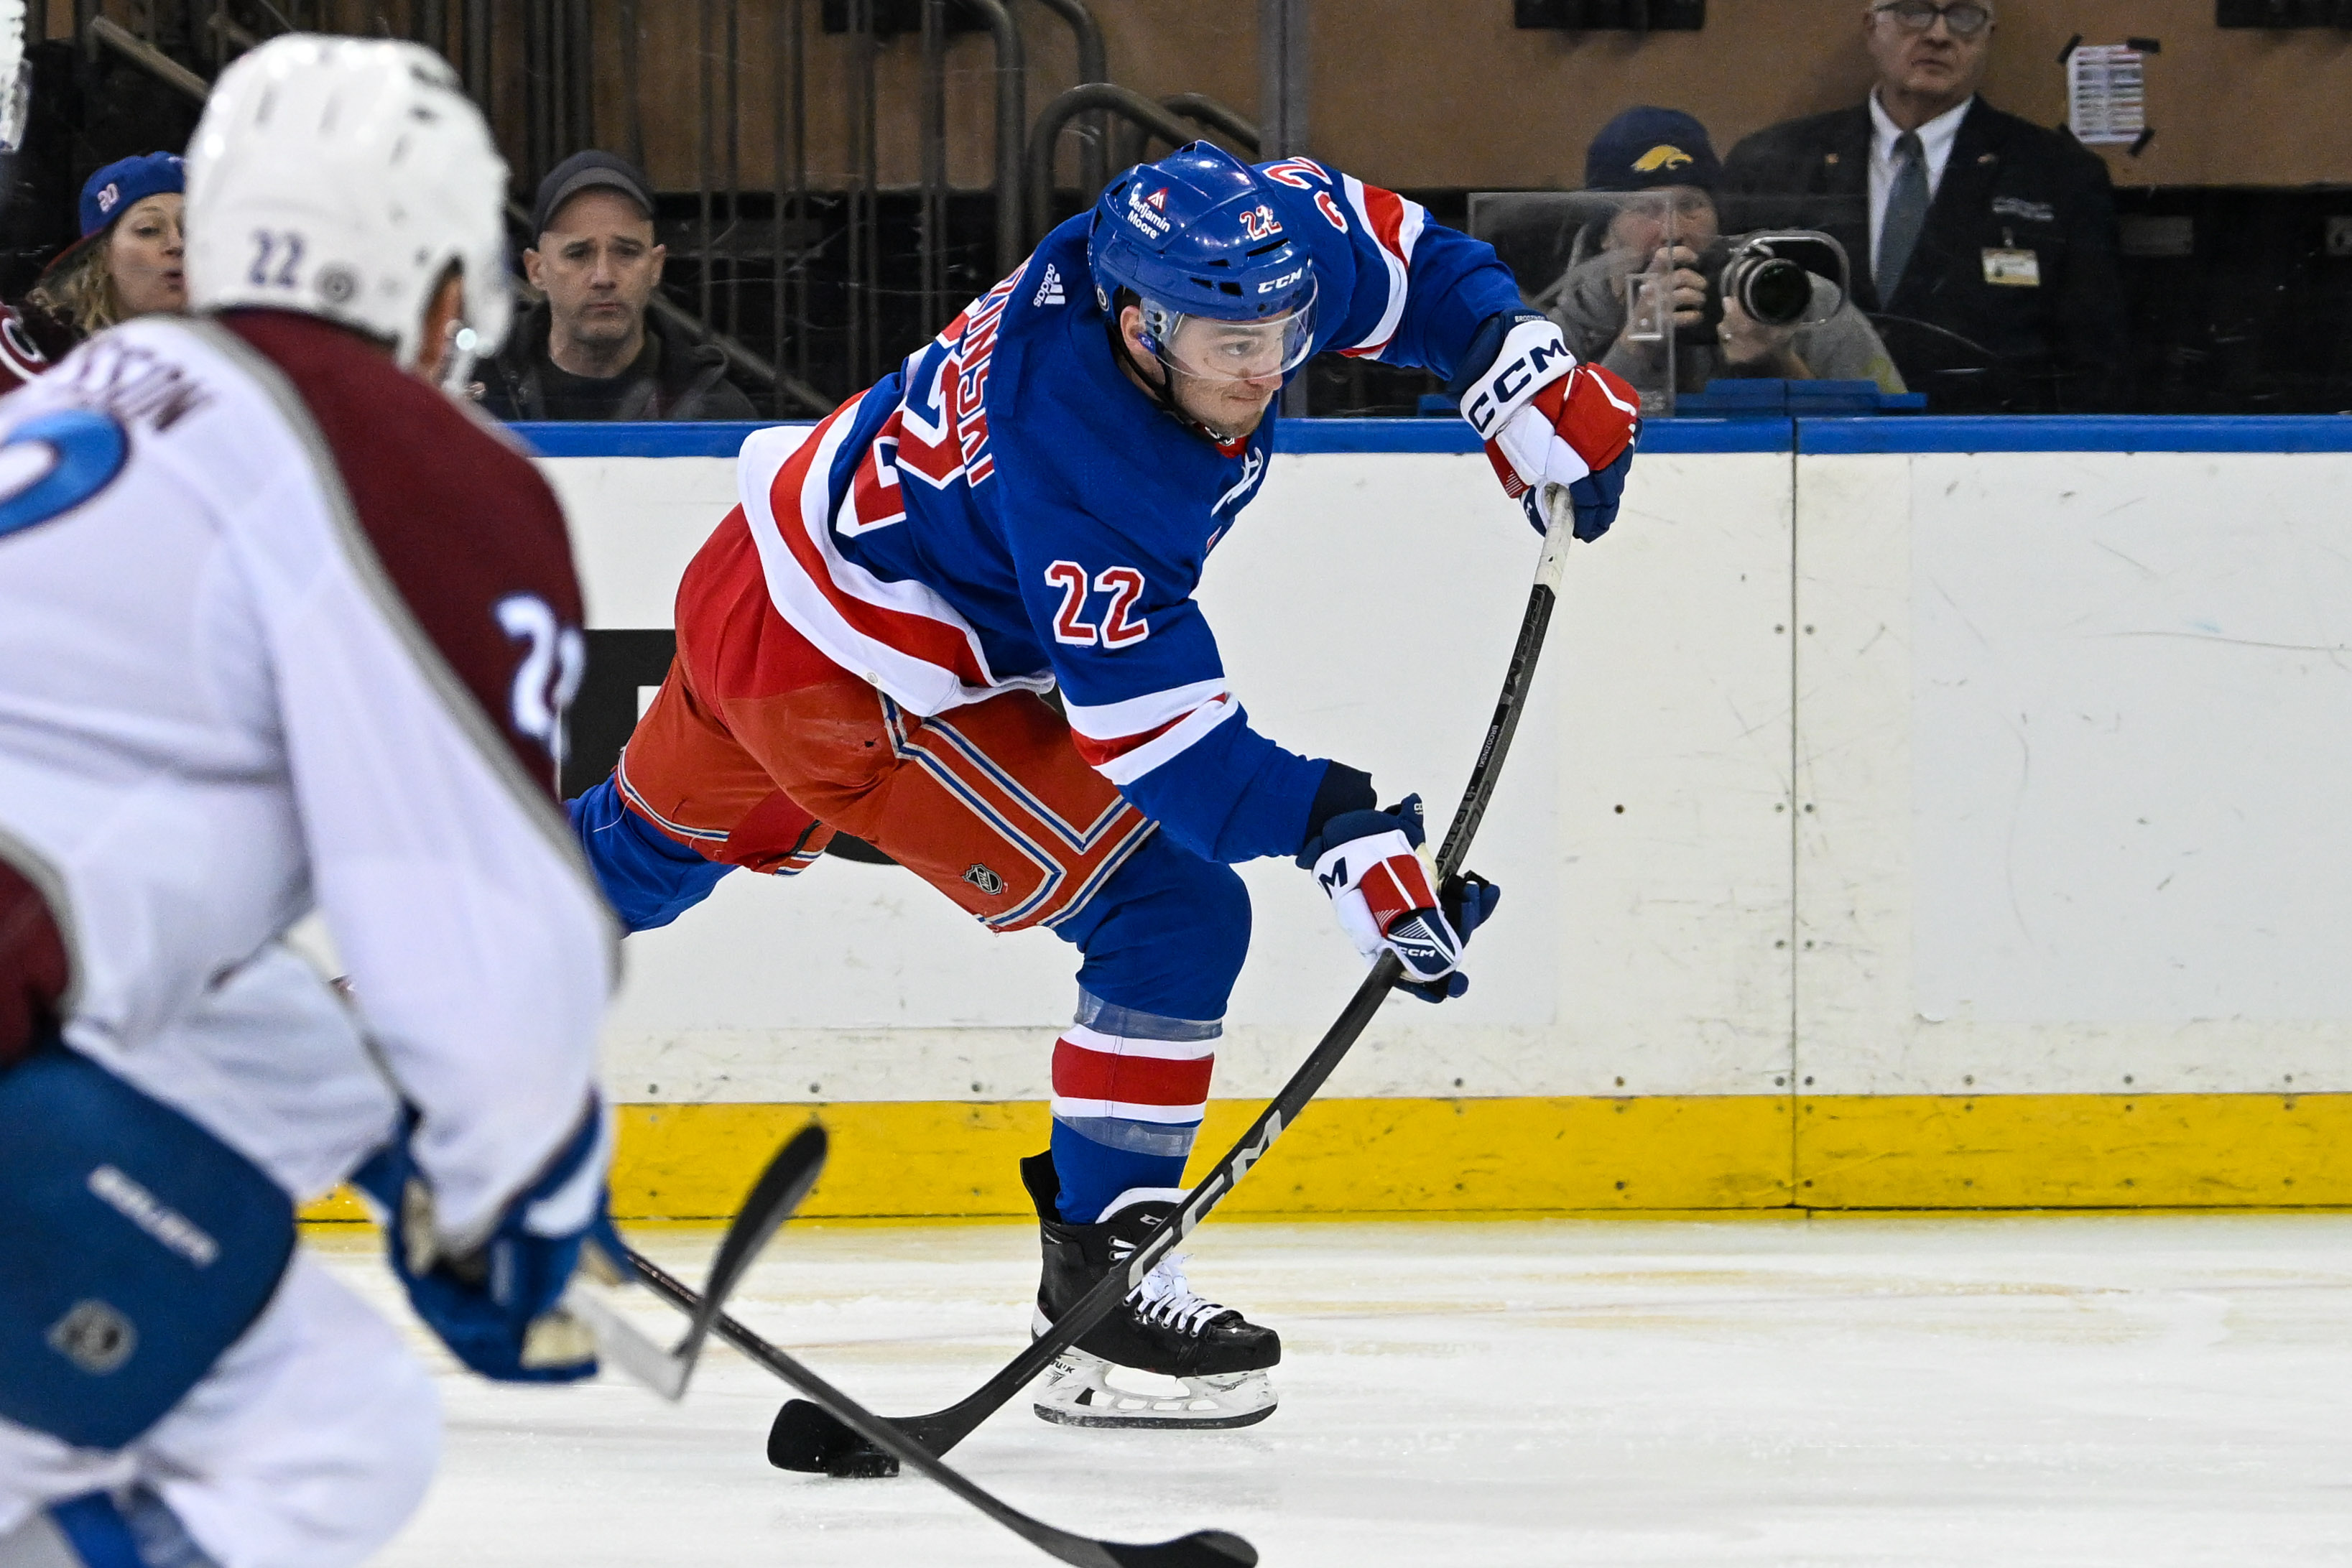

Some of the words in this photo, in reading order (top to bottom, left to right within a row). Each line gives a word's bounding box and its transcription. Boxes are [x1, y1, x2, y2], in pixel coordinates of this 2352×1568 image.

[1129, 194, 1171, 233] Benjamin
[1239, 205, 1283, 241] 22
[248, 228, 307, 289] 22
[1258, 266, 1303, 294] CCM
[1033, 263, 1056, 308] adidas
[1468, 338, 1570, 434] CCM
[1044, 560, 1149, 649] 22
[1129, 1110, 1283, 1291] CCM
